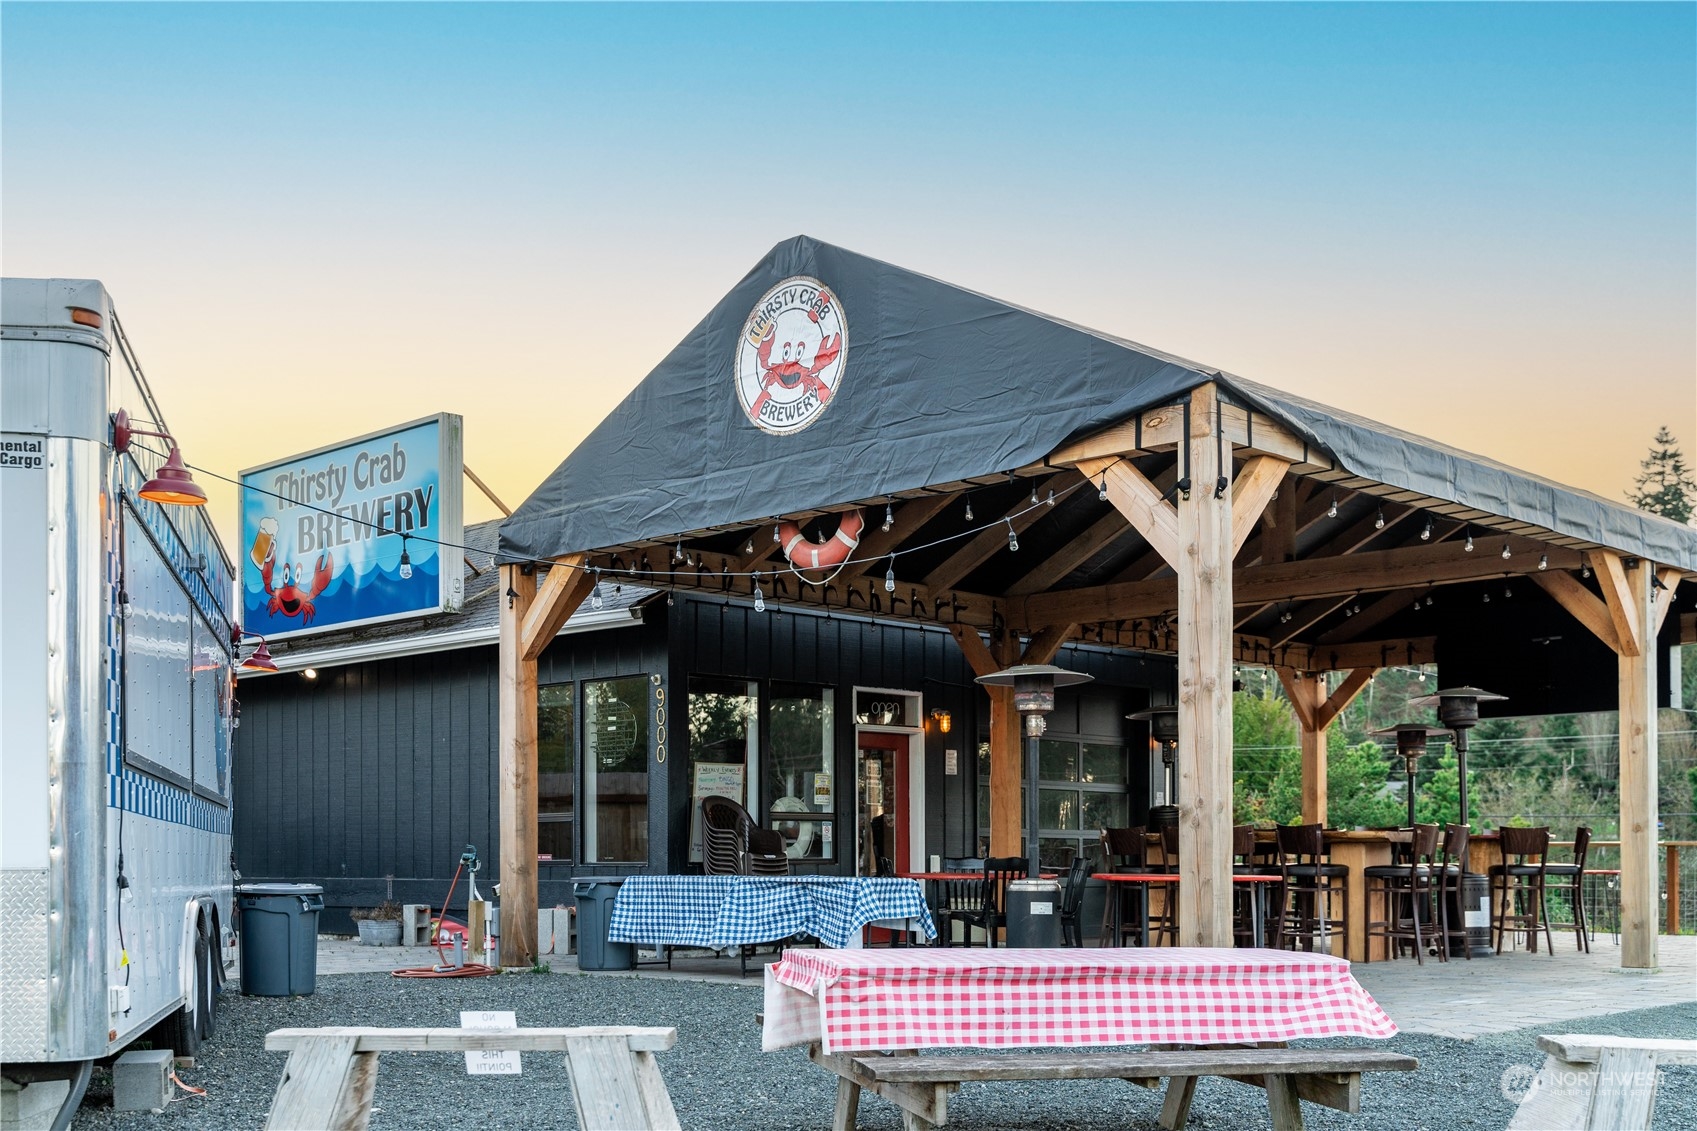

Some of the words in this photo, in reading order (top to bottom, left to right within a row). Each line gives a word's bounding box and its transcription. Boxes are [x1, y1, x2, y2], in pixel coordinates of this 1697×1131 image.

[750, 288, 797, 337] THIRSTY
[800, 289, 830, 320] CRAB
[760, 388, 819, 421] BREWERY
[0, 452, 42, 469] Cargo
[274, 463, 347, 511] Thirsty
[353, 442, 406, 491] Crab
[298, 485, 433, 554] BREWERY
[656, 688, 666, 763] 9000
[871, 701, 900, 717] open
